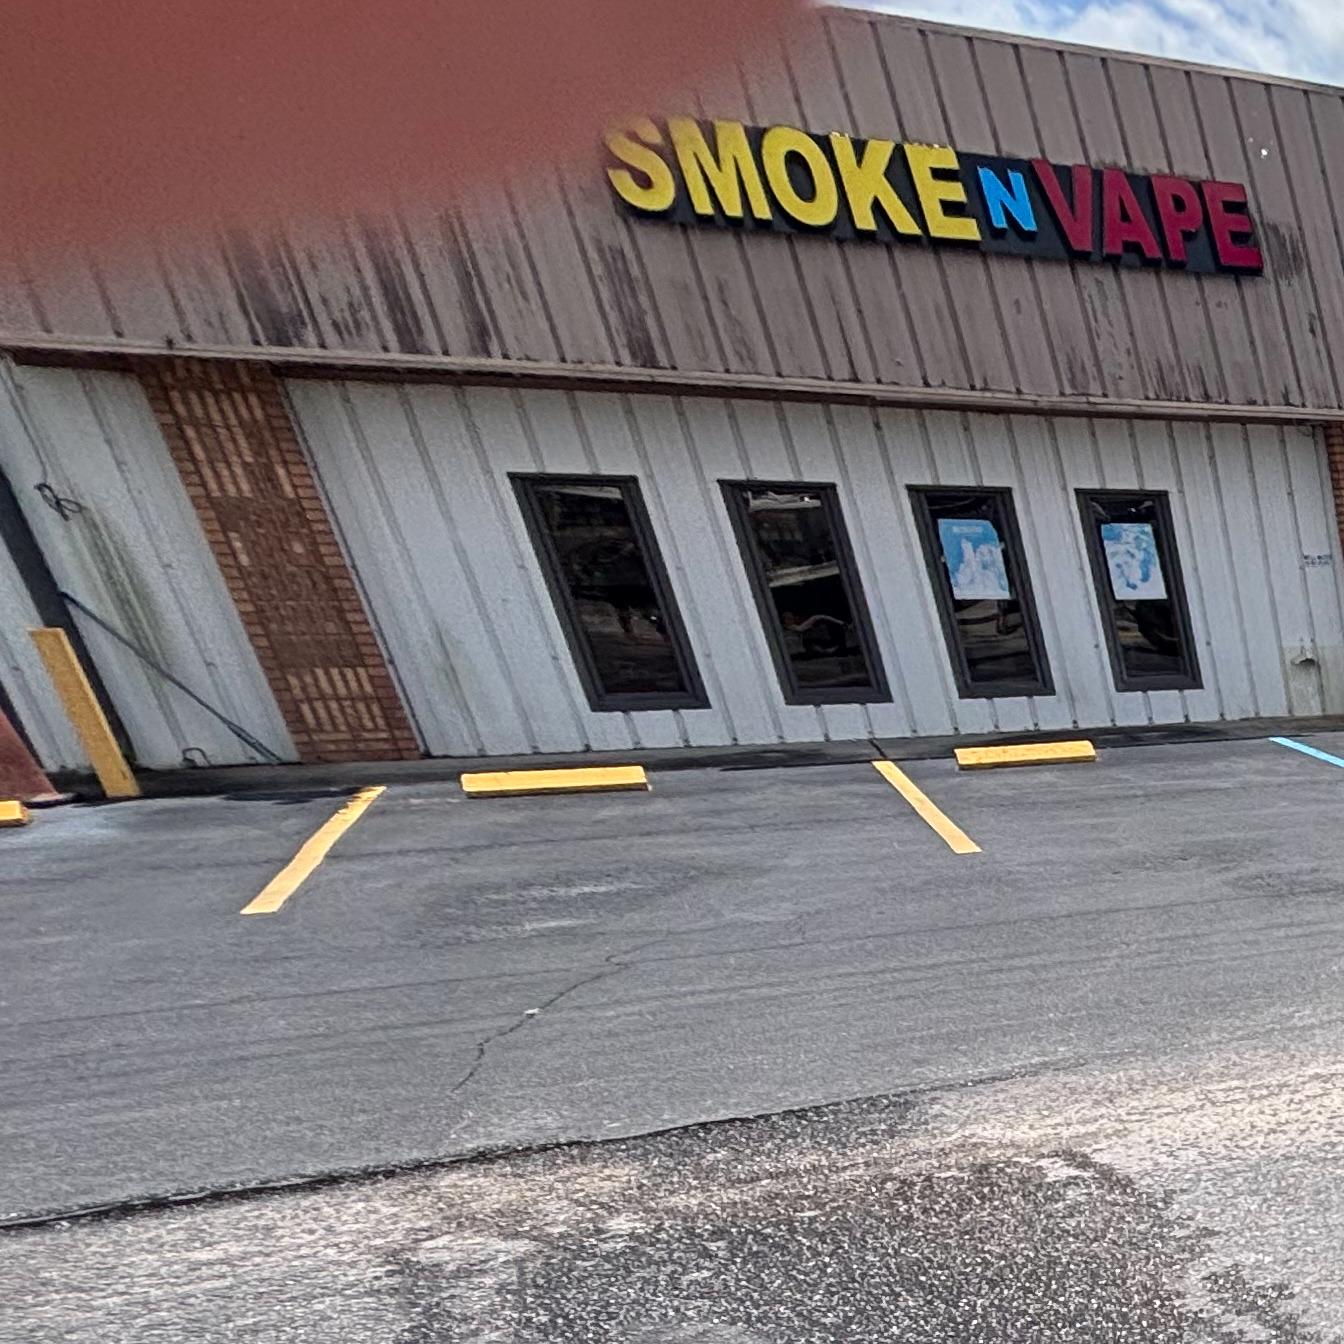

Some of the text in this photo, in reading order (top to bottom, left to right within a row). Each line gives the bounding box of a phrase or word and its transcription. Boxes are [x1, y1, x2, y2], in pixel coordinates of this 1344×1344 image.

[603, 115, 1263, 271] SMOKE N VAPE
